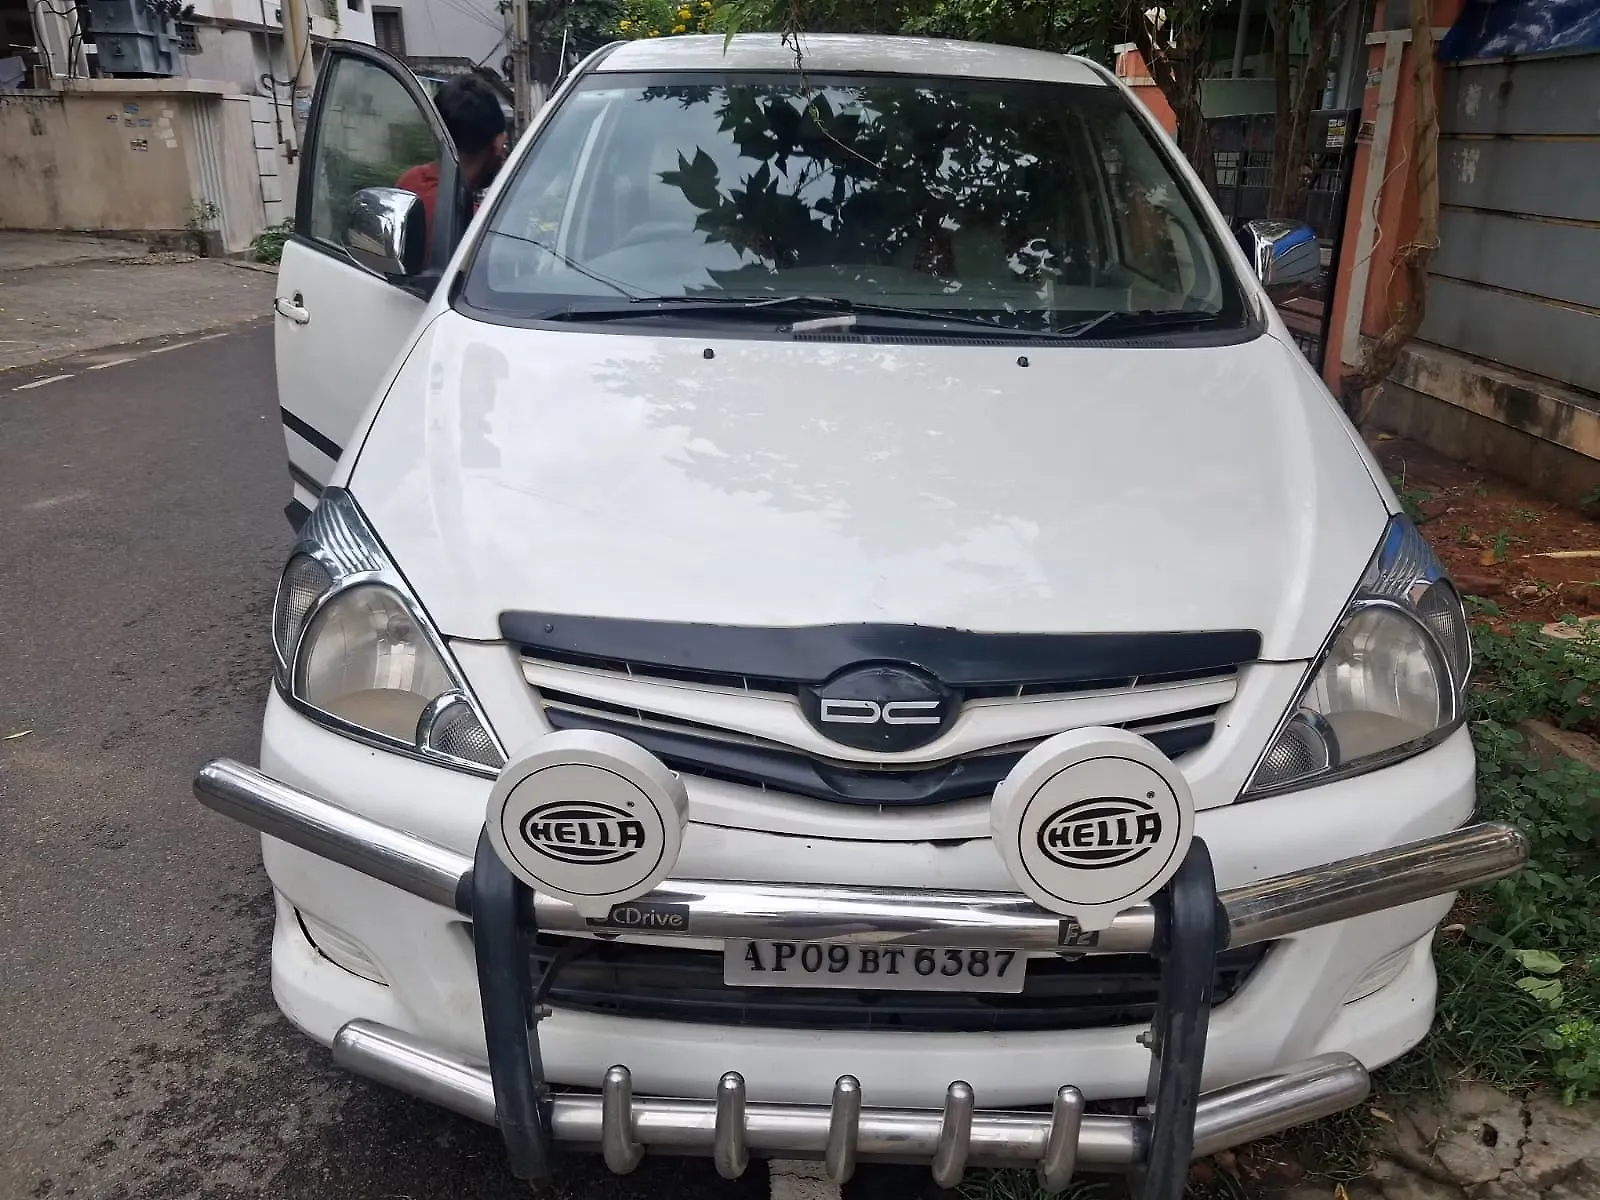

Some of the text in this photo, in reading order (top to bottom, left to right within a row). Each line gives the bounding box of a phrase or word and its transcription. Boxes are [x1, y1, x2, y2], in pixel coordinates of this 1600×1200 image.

[821, 699, 941, 724] DC
[531, 820, 645, 848] HELLA
[1048, 813, 1162, 848] HELLA
[595, 907, 683, 926] CDrive
